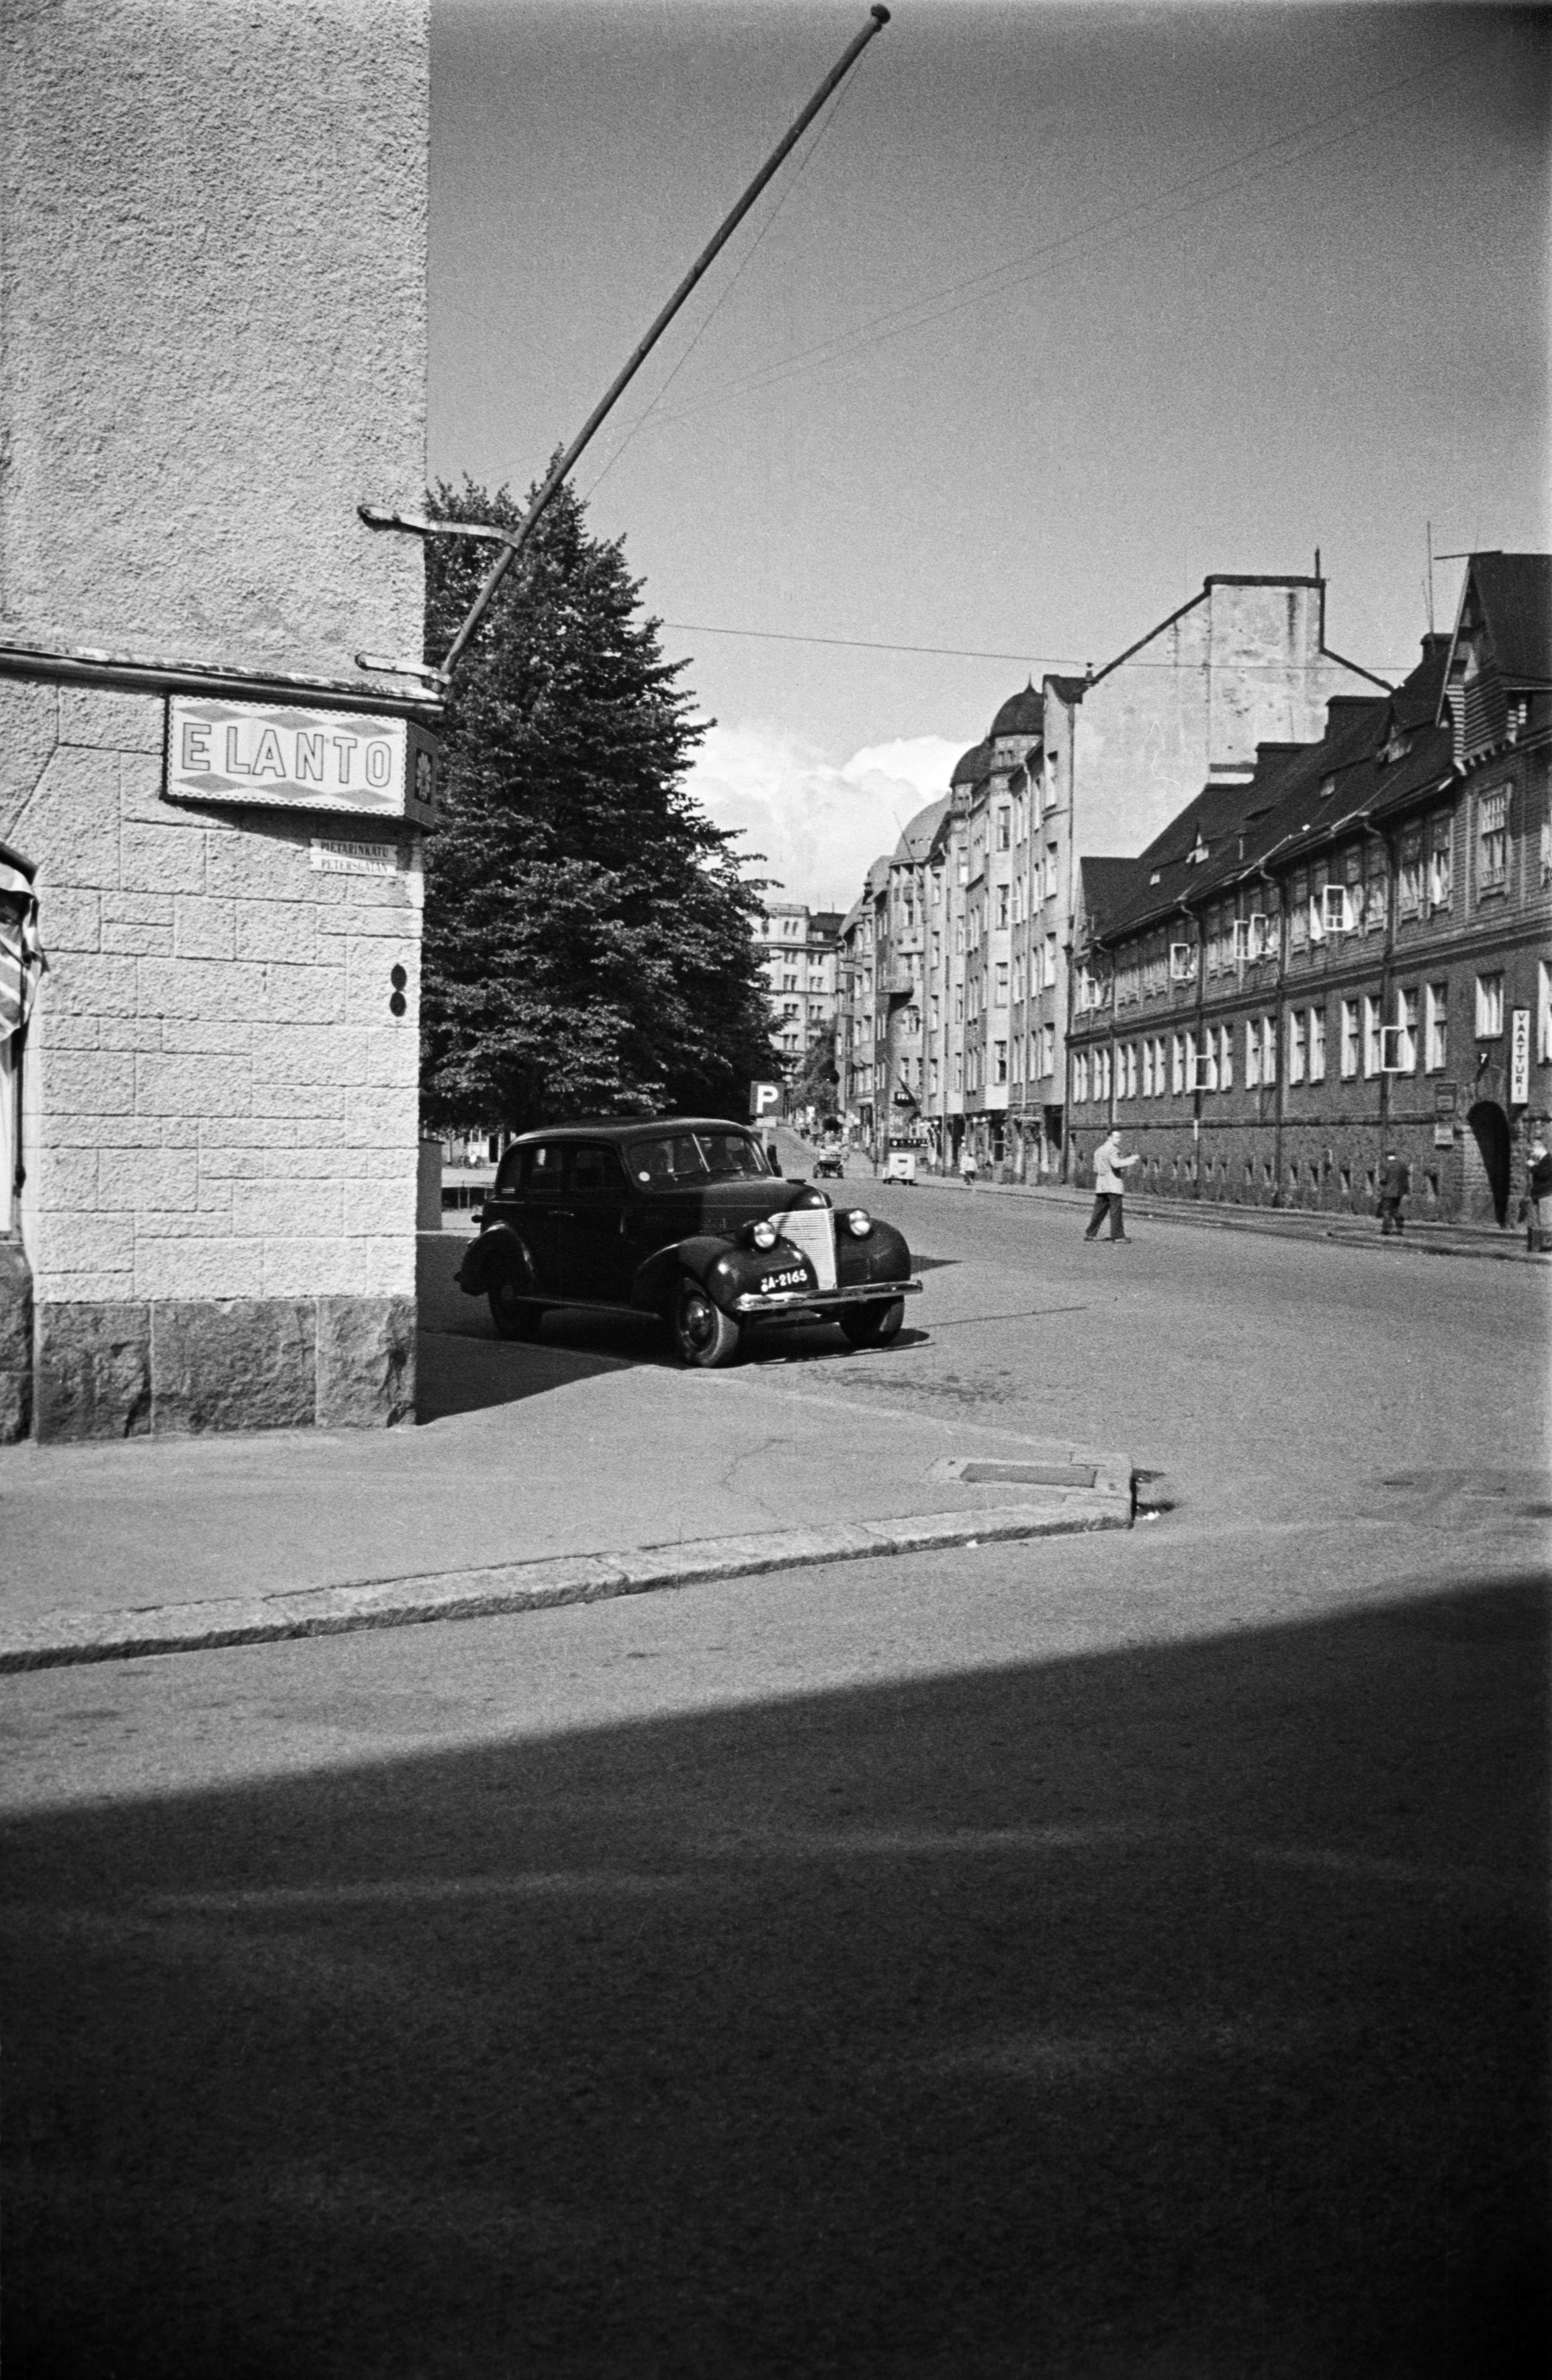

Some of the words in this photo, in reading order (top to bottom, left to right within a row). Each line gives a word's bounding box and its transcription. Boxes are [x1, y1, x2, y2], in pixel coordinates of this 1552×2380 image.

[182, 722, 392, 787] ELANTO
[321, 842, 390, 858] PIETARINKATU
[321, 858, 387, 873] PETERSGATAN
[1516, 1012, 1526, 1095] VAATTURI
[756, 1085, 778, 1113] P
[768, 1269, 808, 1289] A-2165
